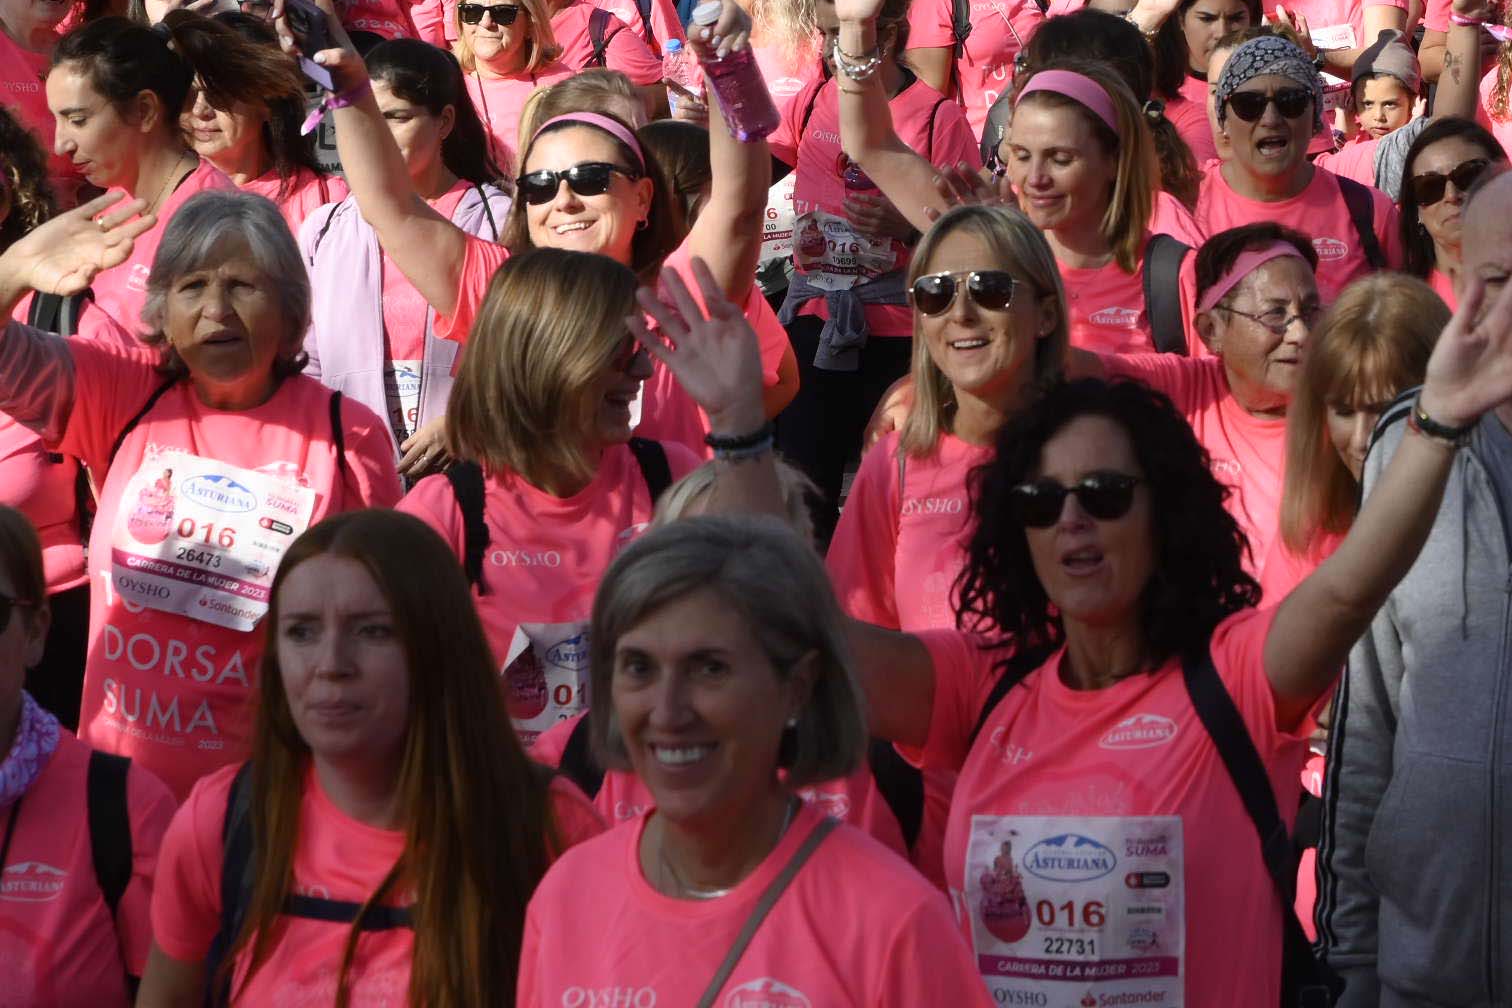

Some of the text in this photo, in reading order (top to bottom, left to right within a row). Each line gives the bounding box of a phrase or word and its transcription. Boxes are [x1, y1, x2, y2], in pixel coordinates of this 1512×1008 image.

[186, 486, 254, 512] ASTURIANA
[901, 498, 961, 515] OYSHO
[178, 517, 237, 551] 016
[177, 547, 224, 571] 26473
[118, 575, 170, 599] OYSHO
[126, 556, 175, 576] CARRERA
[177, 568, 192, 580] DE
[193, 571, 206, 582] LA
[241, 583, 267, 598] 2023
[210, 598, 256, 620] Santande
[103, 624, 247, 687] DORSA
[103, 678, 218, 735] SUMA
[1029, 851, 1109, 870] ASTURIANA
[1035, 898, 1105, 927] 016
[1044, 937, 1095, 956] 22731
[1047, 963, 1063, 974] DE
[1066, 965, 1082, 975] LA
[563, 987, 656, 1008] OYSHO
[994, 988, 1167, 1006] OYSHO Santander
